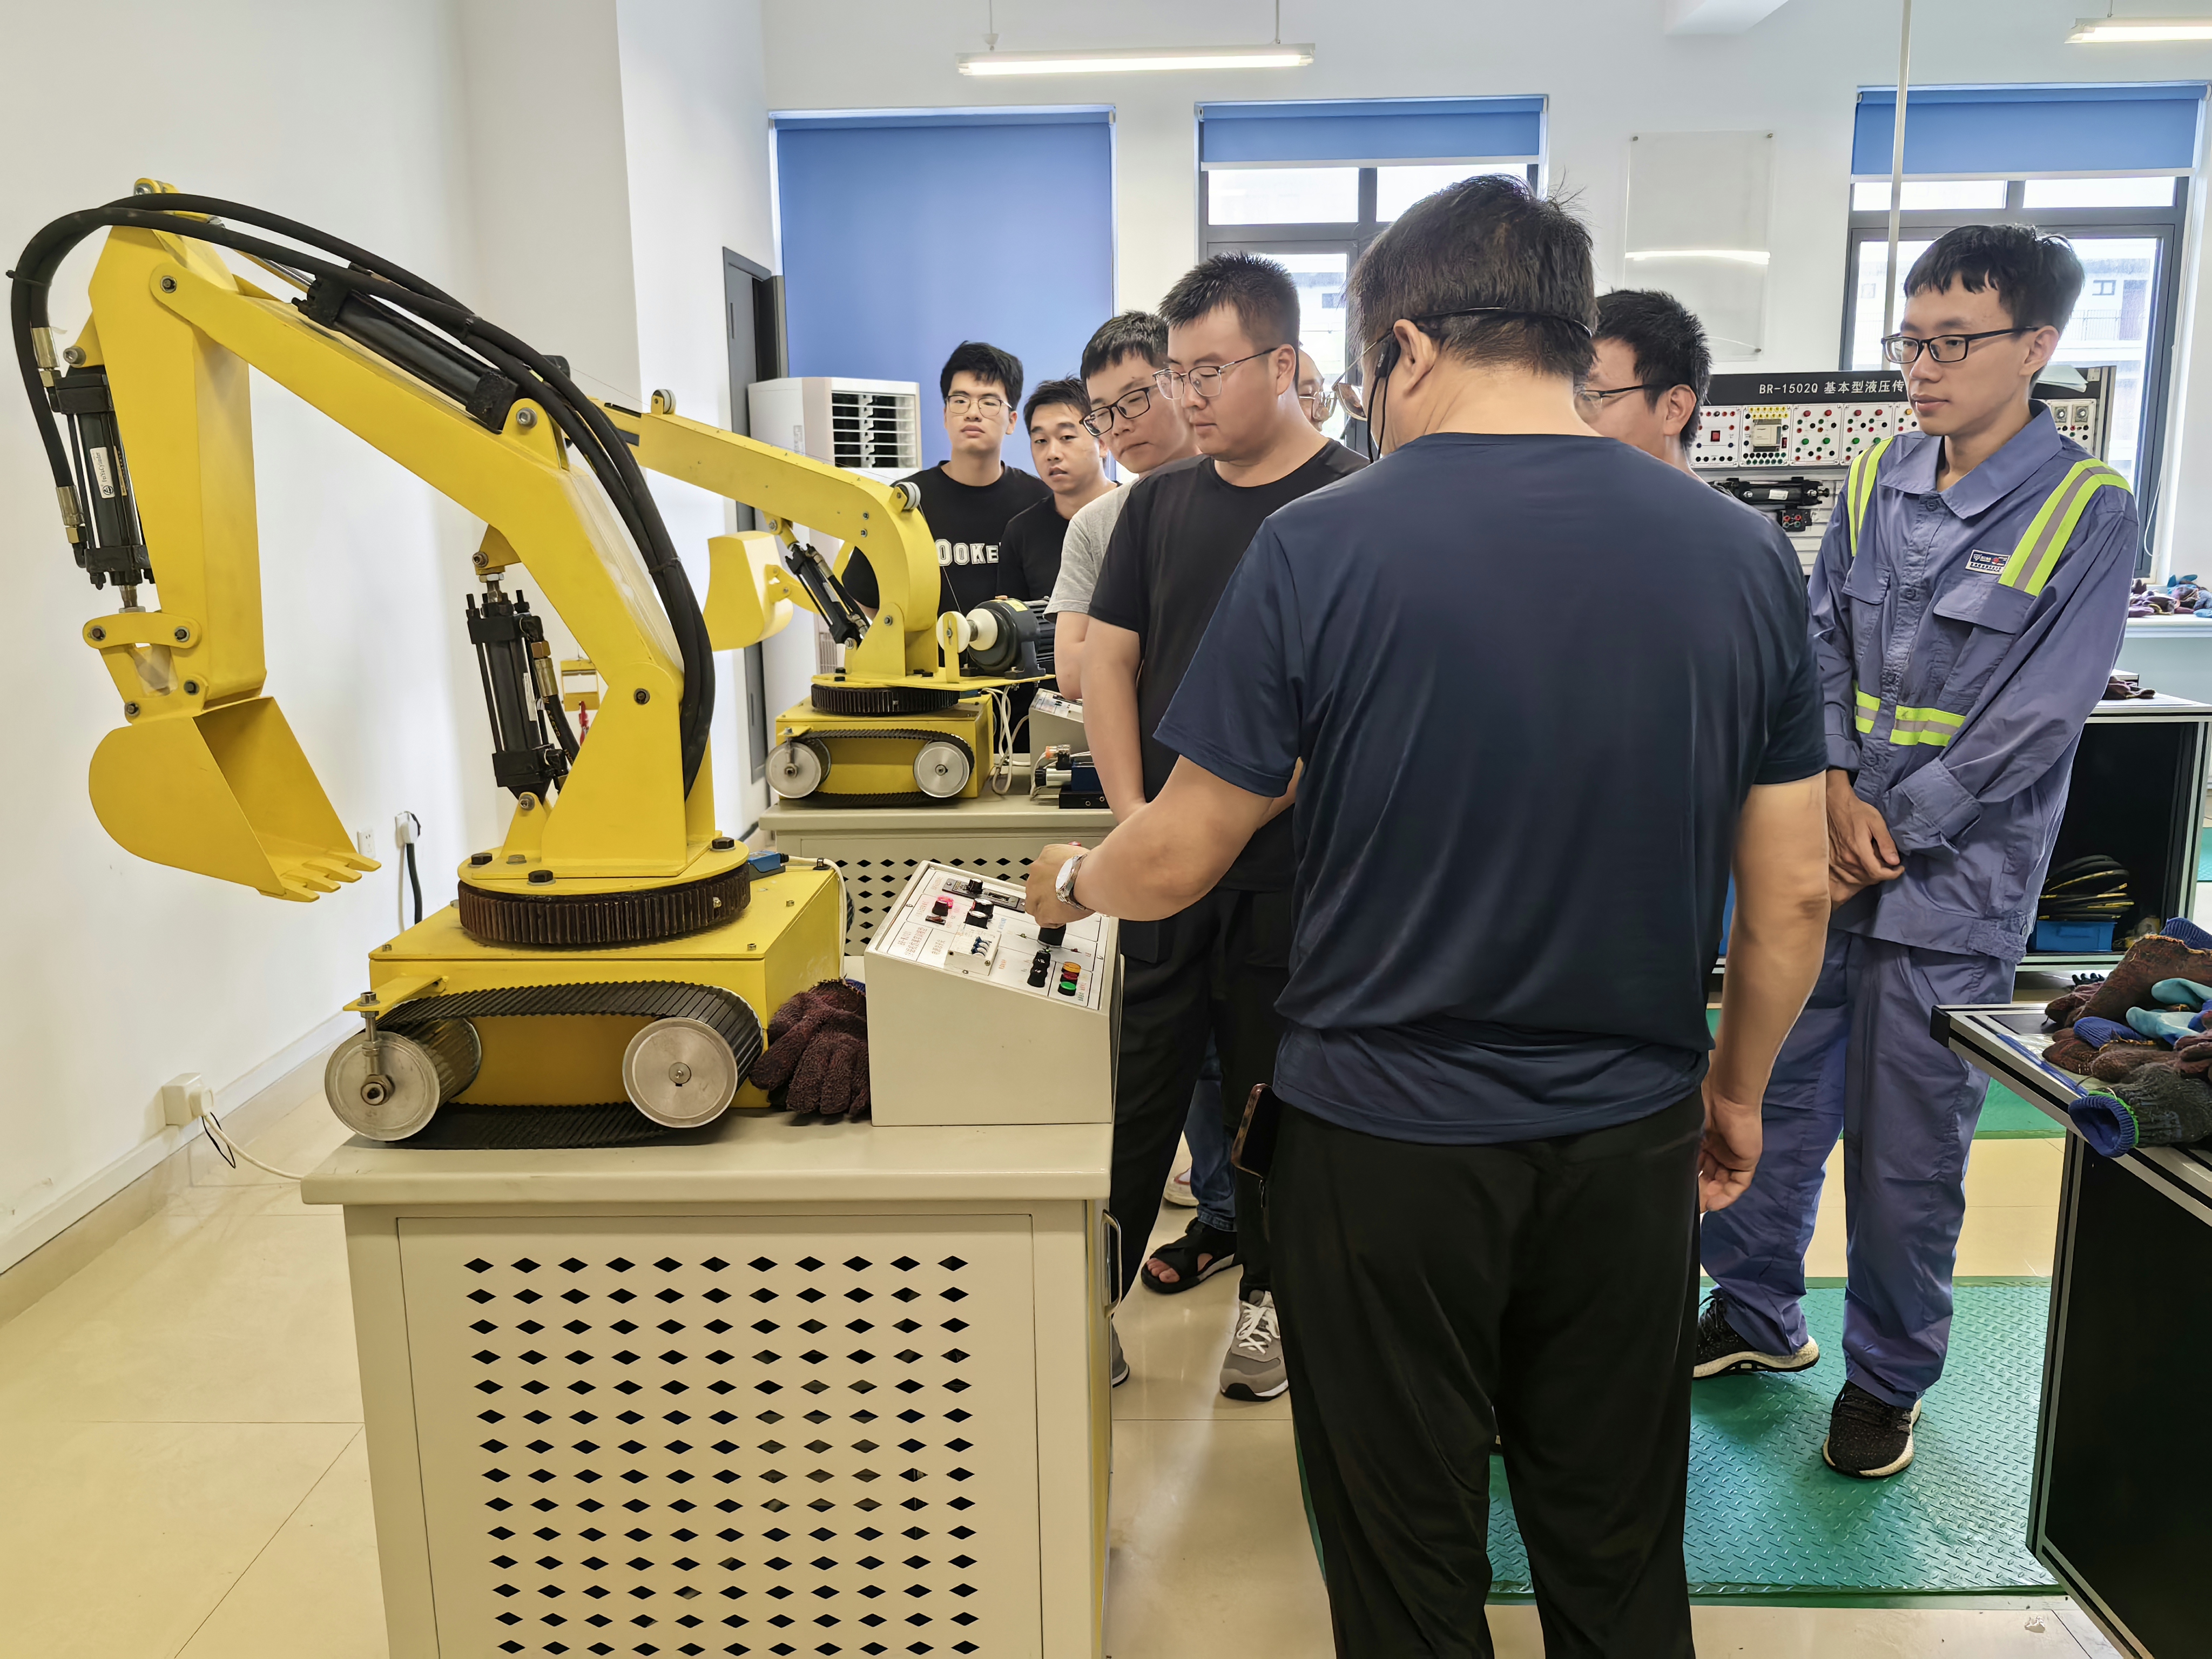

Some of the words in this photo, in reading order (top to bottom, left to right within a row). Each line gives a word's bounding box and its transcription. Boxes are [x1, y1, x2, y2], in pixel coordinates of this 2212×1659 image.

[1759, 383, 1818, 394] BR-1502Q
[1824, 379, 1905, 394] 基本型液压传
[935, 538, 1001, 567] OOKE
